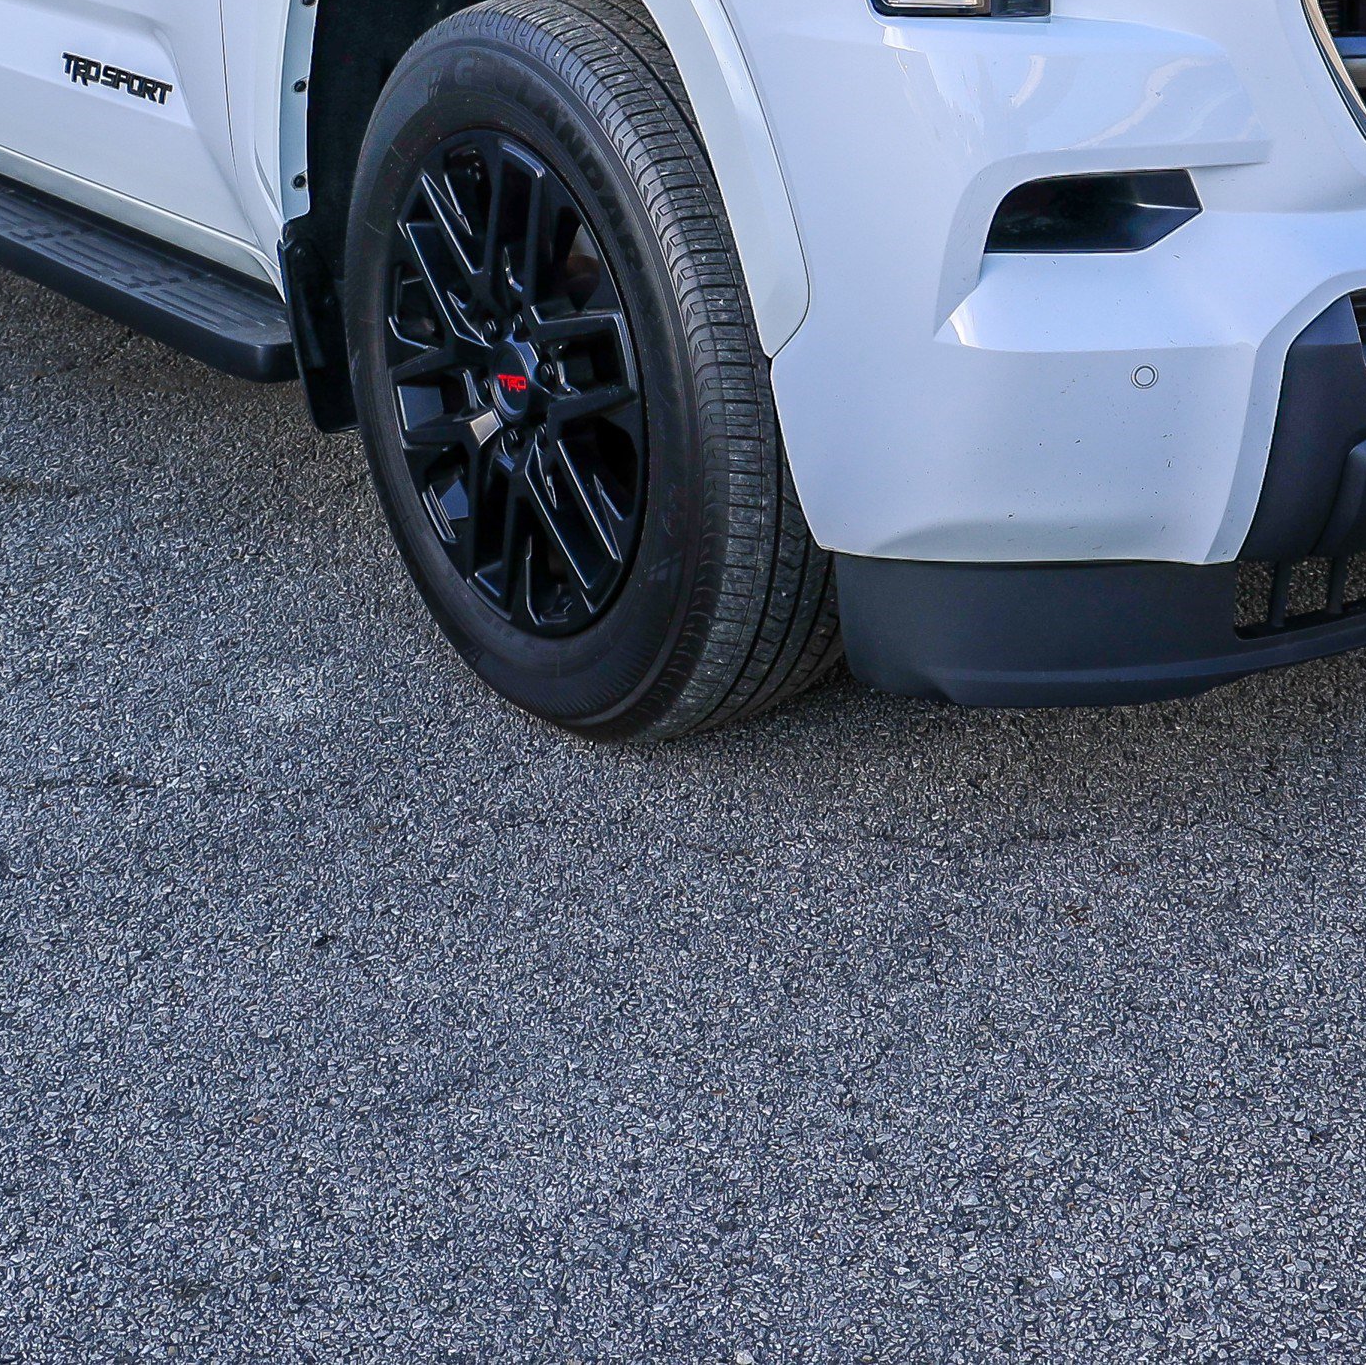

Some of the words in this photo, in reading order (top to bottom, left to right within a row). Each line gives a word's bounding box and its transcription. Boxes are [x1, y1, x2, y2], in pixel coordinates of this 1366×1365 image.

[61, 51, 102, 86] TRD
[99, 64, 174, 106] SPORT
[454, 56, 643, 270] GOLANDAR
[496, 373, 528, 393] TRD
